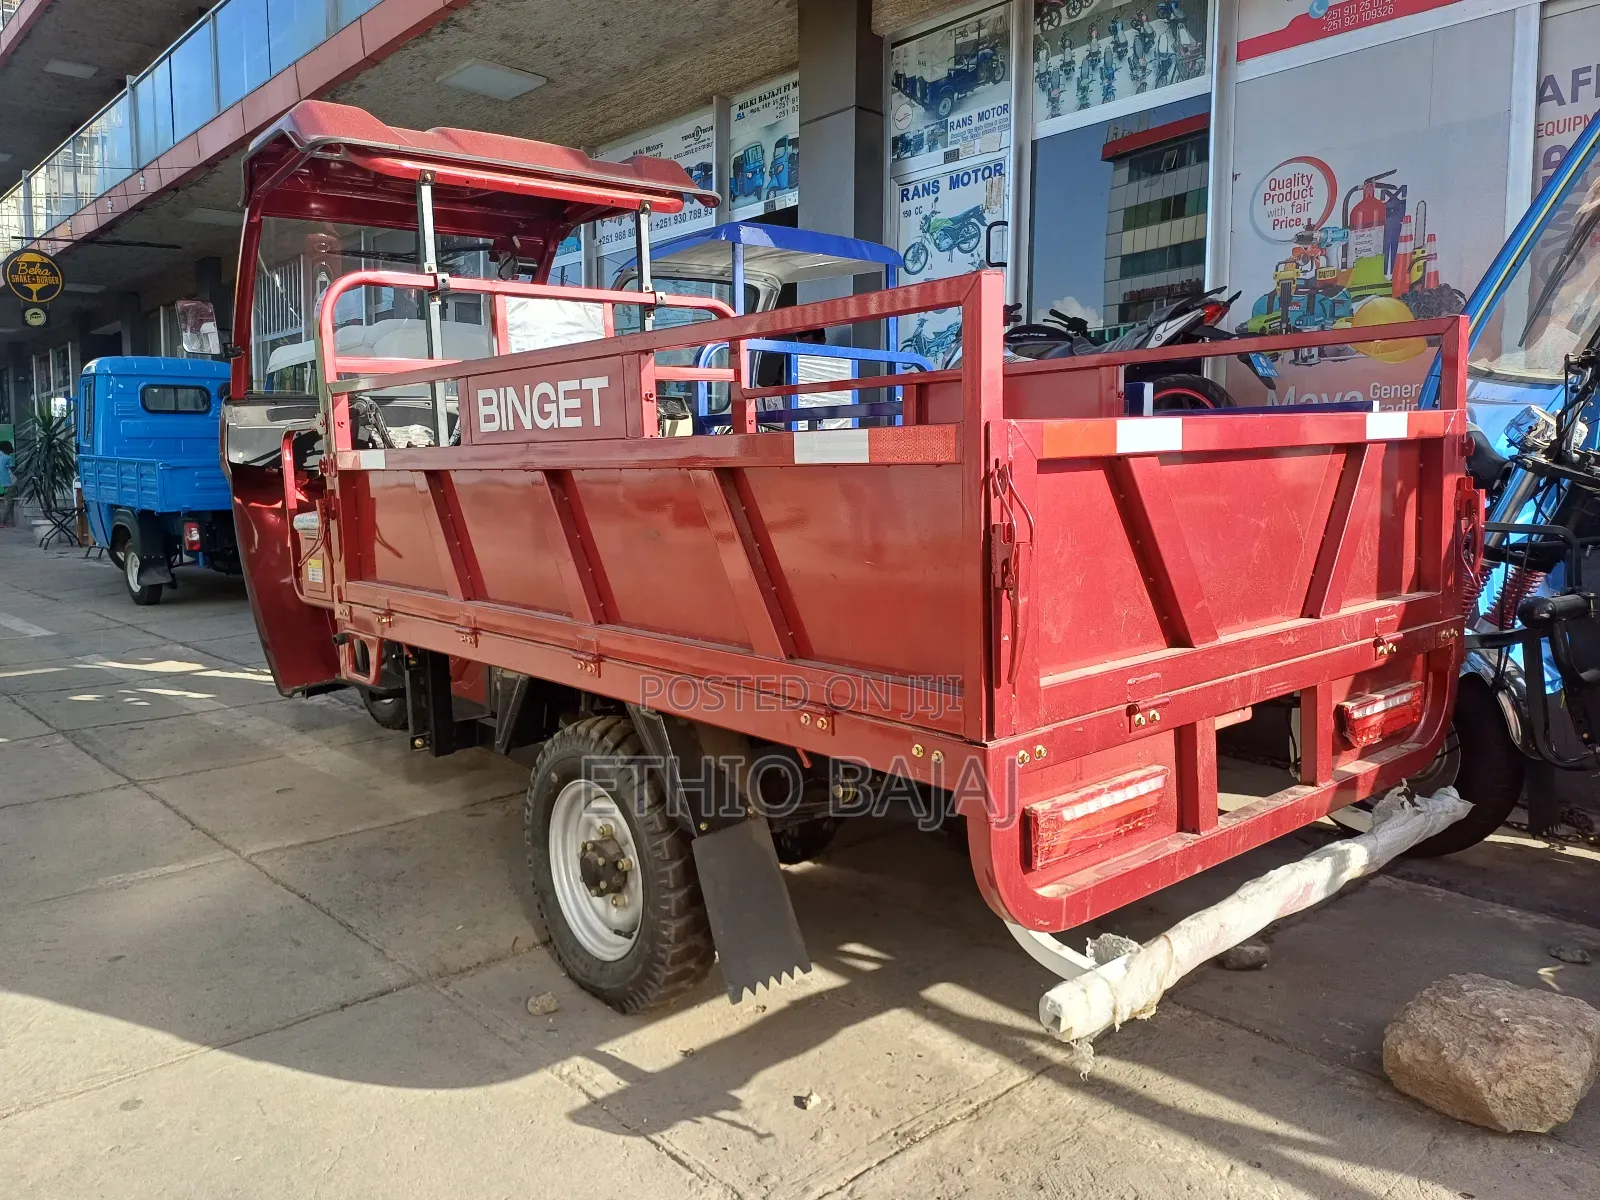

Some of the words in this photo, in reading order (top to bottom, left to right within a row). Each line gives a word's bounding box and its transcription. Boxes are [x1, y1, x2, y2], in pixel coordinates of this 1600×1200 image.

[1322, 9, 1341, 21] +251
[1344, 4, 1357, 16] 911
[1360, 0, 1371, 12] 25
[1322, 19, 1342, 32] +251
[1344, 14, 1359, 27] 921
[1362, 4, 1394, 21] 109326
[738, 98, 757, 111] MILKI
[758, 87, 782, 103] BAJAJI
[949, 114, 973, 132] RANS
[977, 103, 1009, 123] MOTOR
[900, 180, 940, 203] RANS
[948, 162, 1005, 190] MOTOR
[1269, 172, 1313, 191] Quality
[1263, 185, 1314, 206] Product
[902, 209, 912, 218] 150
[914, 205, 923, 216] CC
[1267, 206, 1286, 218] with
[1291, 200, 1312, 214] fair
[599, 234, 613, 245] +251
[655, 217, 672, 229] +251
[674, 212, 687, 224] 930
[689, 208, 702, 221] 789
[1272, 216, 1305, 231] Price.
[11, 274, 32, 283] SHAKE
[36, 275, 60, 285] BURGER
[18, 262, 52, 276] Beka
[1257, 366, 1278, 377] RANS
[477, 376, 609, 433] BINGET
